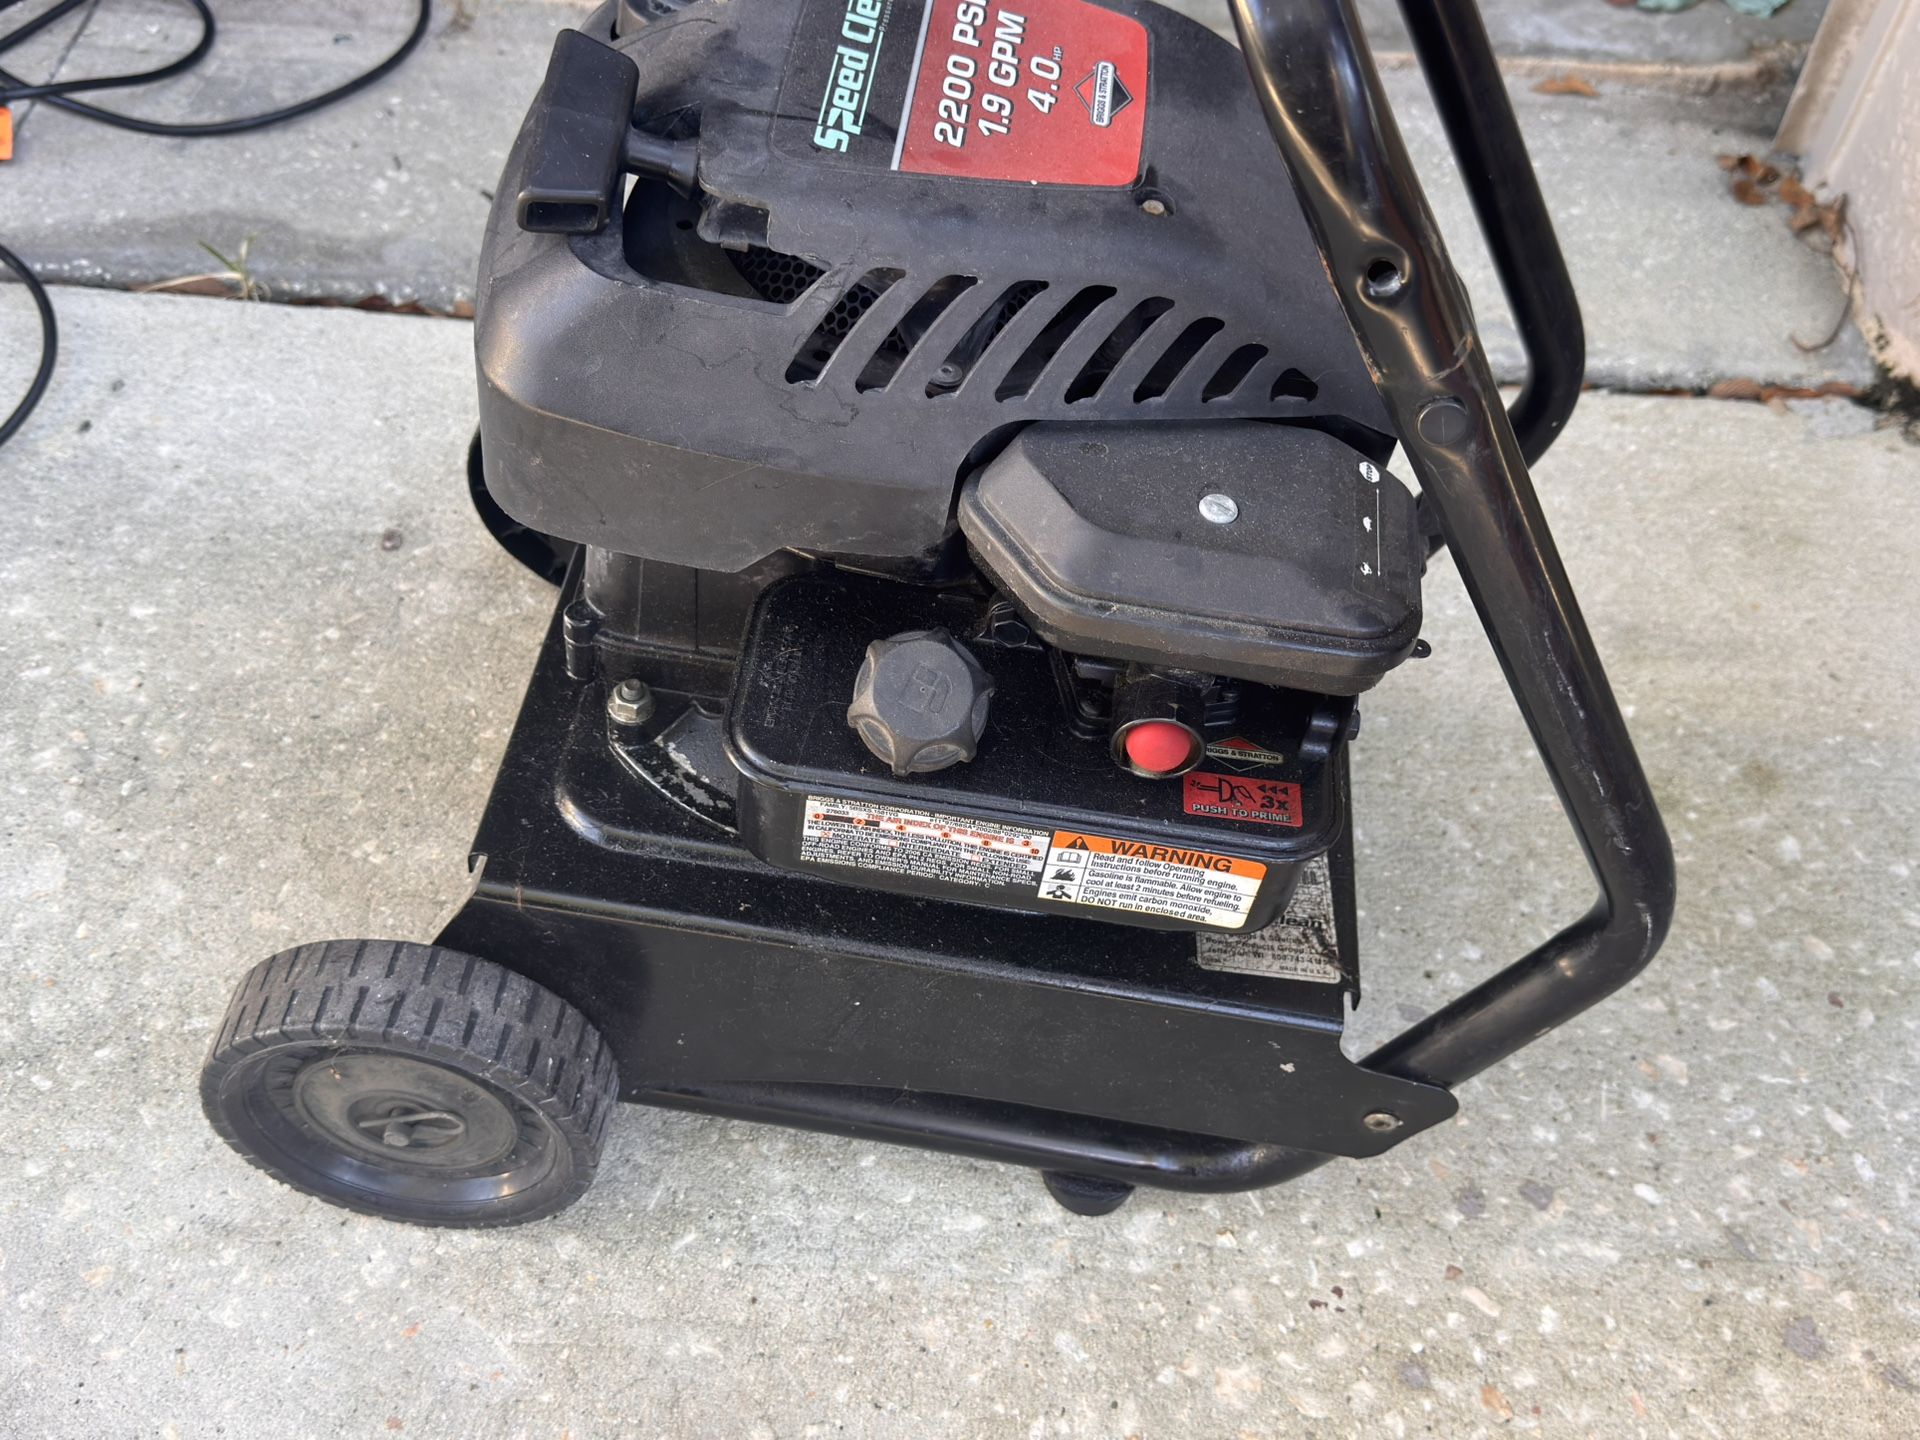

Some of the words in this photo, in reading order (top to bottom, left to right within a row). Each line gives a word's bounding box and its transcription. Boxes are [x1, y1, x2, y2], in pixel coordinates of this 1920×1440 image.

[989, 10, 1025, 87] GPM
[1028, 57, 1060, 113] 4.0
[1053, 46, 1062, 61] HP
[1099, 65, 1110, 93] STRATTON
[814, 45, 869, 152] Speed
[934, 55, 976, 148] 2200
[1096, 100, 1106, 123] BRIGGS
[978, 94, 1012, 136] 1.9
[1238, 751, 1279, 760] STRATTON
[842, 799, 878, 808] STRATTON
[880, 805, 929, 816] CORPORATION
[935, 813, 973, 823] IMPORTANT
[976, 820, 1000, 828] ENGINE
[1002, 825, 1049, 836] INFORMATION
[1193, 803, 1227, 815] PUSH
[1232, 808, 1248, 817] TO
[1251, 810, 1292, 822] PRIME
[832, 833, 880, 843] MODERATE
[866, 813, 884, 821] THE
[904, 819, 931, 828] INDEX
[948, 826, 968, 835] THIS
[970, 831, 1004, 842] ENGINE
[815, 826, 854, 834] CALIFORNIA
[875, 833, 909, 842] EMISSIONS
[911, 839, 948, 848] COMPLIANT
[977, 851, 1015, 862] FOLLOWING
[850, 841, 890, 850] CONFORMS
[935, 853, 970, 865] EMISSION
[899, 842, 960, 857] INTERMEDIATE
[963, 842, 978, 850] THIS
[979, 847, 1003, 855] ENGINE
[1010, 852, 1043, 861] CERTIFIED
[1111, 840, 1233, 873] WARNING
[817, 858, 856, 867] EMISSIONS
[858, 863, 905, 874] COMPLIANCE
[906, 870, 936, 878] PERIOD:
[939, 875, 980, 886] CATEGORY:
[841, 845, 874, 854] ENGINES
[993, 870, 1032, 880] NON-ROAD
[875, 859, 910, 869] EMISSION
[911, 865, 953, 876] DURABILITY
[910, 860, 940, 869] MANUAL
[959, 868, 1010, 882] MAINTENANCE
[982, 858, 1028, 869] EXTENDED
[1091, 860, 1141, 873] Instructions
[1143, 867, 1170, 877] before
[1172, 872, 1206, 885] running
[1207, 879, 1238, 891] engine.
[1093, 853, 1115, 862] Read
[1116, 856, 1133, 865] and
[1135, 858, 1162, 868] follow
[1163, 862, 1205, 877] Operating
[1086, 878, 1103, 887] cool
[1114, 881, 1134, 890] least
[1142, 885, 1174, 897] minutes
[1176, 892, 1202, 902] before
[1203, 897, 1240, 912] refueling.
[1088, 870, 1124, 881] Gasoline
[1125, 874, 1133, 882] is
[1134, 875, 1178, 889] flammable.
[1180, 883, 1203, 894] Allow
[1204, 889, 1232, 900] engine
[1080, 895, 1095, 904] DO
[1097, 898, 1117, 907] NOT
[1119, 901, 1133, 909] run
[1134, 902, 1142, 910] in
[1144, 904, 1186, 918] enclosed
[1187, 913, 1207, 922] area.
[1083, 887, 1117, 898] Engines
[1118, 891, 1137, 900] emit
[1139, 895, 1168, 906] carbon
[1170, 901, 1212, 916] monoxide,
